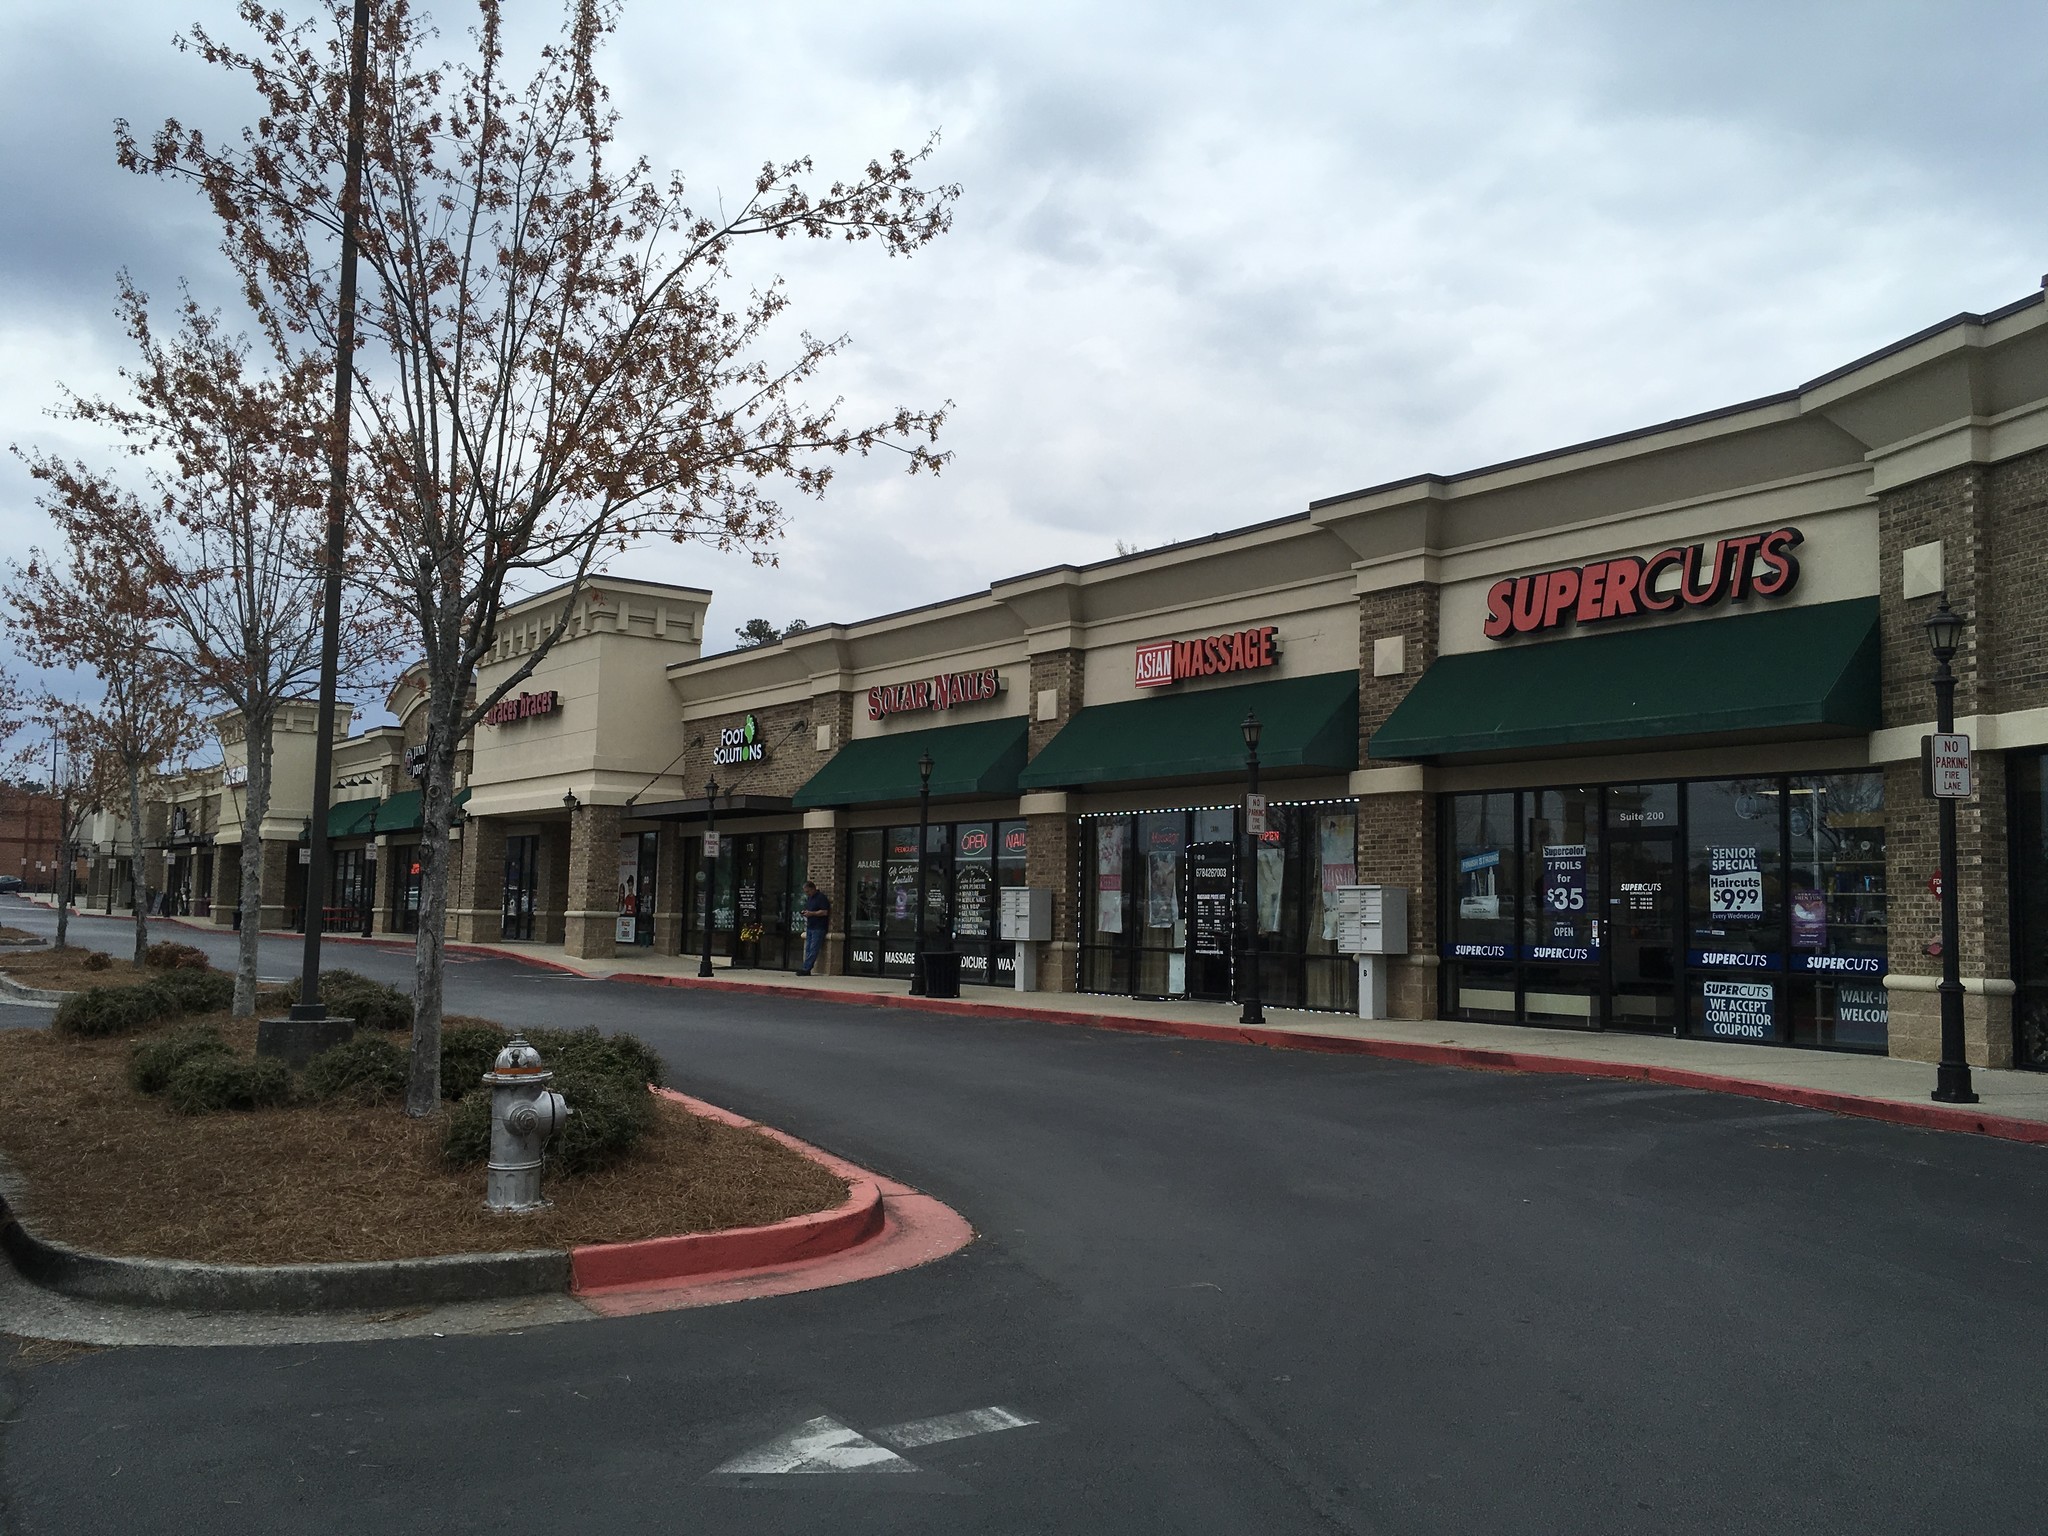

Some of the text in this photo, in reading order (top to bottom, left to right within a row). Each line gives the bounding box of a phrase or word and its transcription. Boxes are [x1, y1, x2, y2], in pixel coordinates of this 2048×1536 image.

[1485, 528, 1803, 639] SUPERCUTS
[1173, 627, 1277, 679] MASSAGE
[868, 669, 998, 720] SOLAR NAILS
[721, 728, 745, 746] FOOT
[1944, 741, 1958, 753] NO
[713, 743, 762, 765] SOLUTIONS
[1936, 756, 1968, 769] PARKING
[1945, 771, 1960, 779] FIRE
[1944, 782, 1961, 790] LANE
[1252, 799, 1260, 807] NO
[1248, 808, 1265, 817] PARKING
[1620, 811, 1664, 822] Suite 200
[961, 833, 988, 850] OPEN
[1005, 832, 1026, 849] NAIL
[1260, 831, 1280, 841] OPEN
[1544, 846, 1585, 857] Supercolor
[1712, 847, 1756, 860] SENIOR
[1547, 860, 1582, 870] 7 FOILS
[1712, 859, 1758, 871] SPECIAL
[1556, 874, 1571, 883] for
[1711, 877, 1760, 888] Haircuts
[1620, 882, 1662, 892] SUPERCUTS
[1547, 887, 1584, 910] $35
[1713, 888, 1759, 911] $9.99
[1712, 912, 1761, 922] Every Wednesday
[1553, 927, 1574, 937] OPEN
[853, 950, 874, 963] NAILS
[1455, 944, 1505, 957] SUPERCUTS
[1533, 947, 1588, 960] SUPERCUTS
[884, 951, 916, 965] MASSAGE
[961, 955, 987, 970] DICURE
[1702, 952, 1767, 967] SUPERCUTS
[1806, 956, 1879, 972] SUPERCUTS
[1705, 984, 1770, 1000] SUPERCUTS
[1841, 989, 1889, 1005] WALK-IN
[1710, 998, 1767, 1013] WE ACCEPT
[1705, 1010, 1772, 1026] COMPETITOR
[1840, 1007, 1889, 1024] WELCOM
[1713, 1023, 1764, 1038] COUPONS
